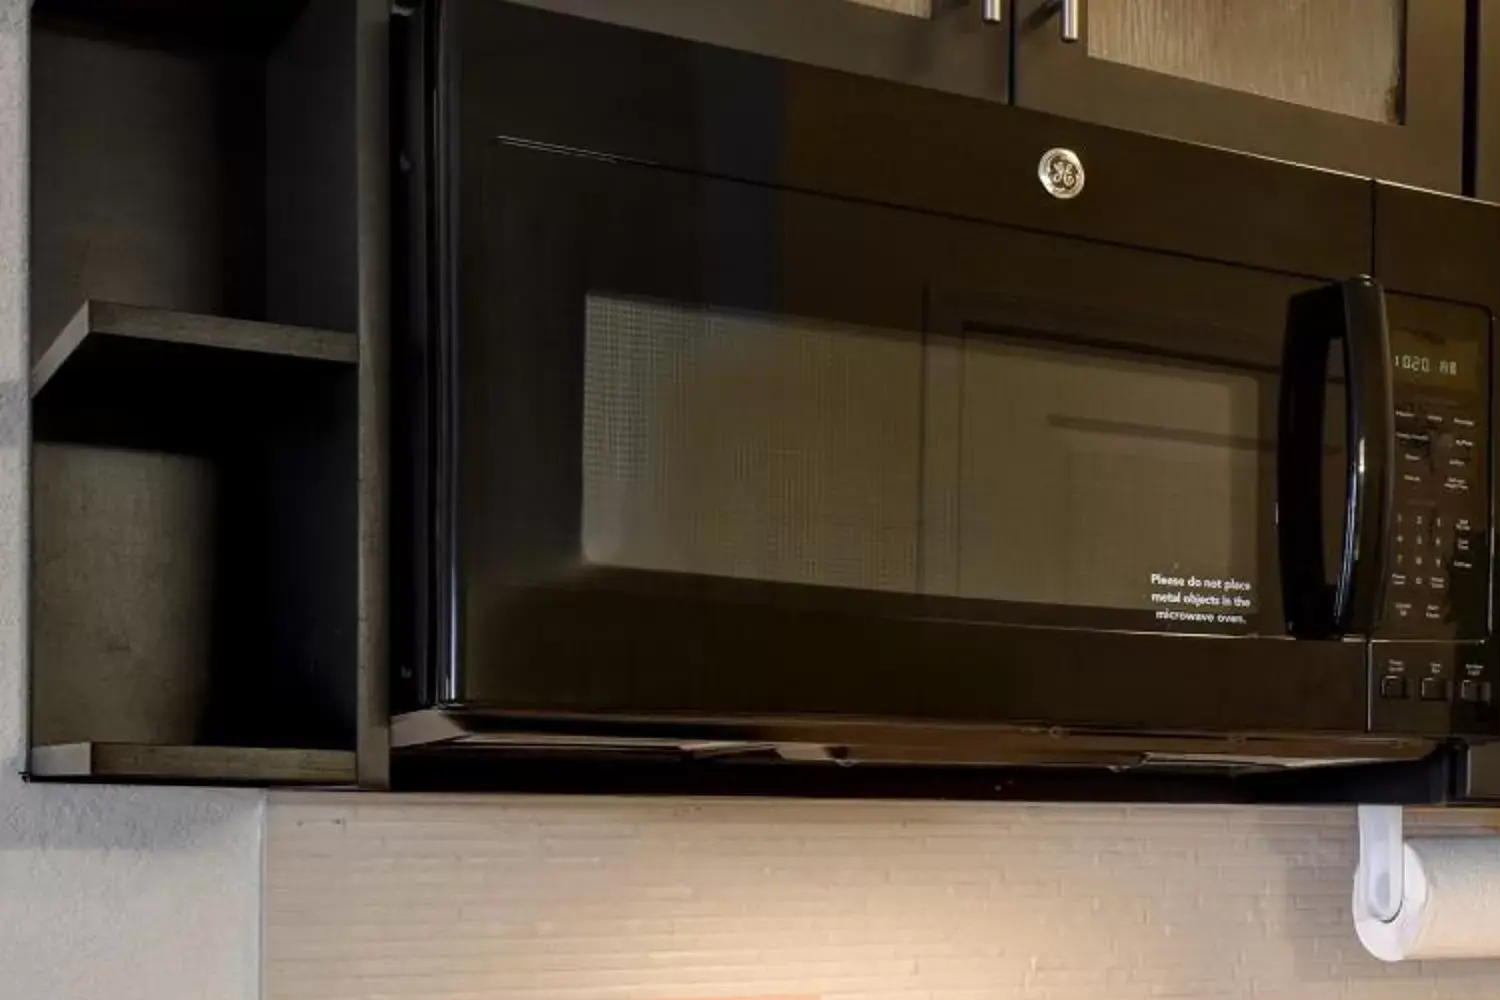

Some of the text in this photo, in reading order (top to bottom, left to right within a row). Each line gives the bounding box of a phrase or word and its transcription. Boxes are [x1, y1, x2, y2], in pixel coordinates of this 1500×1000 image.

[1151, 573, 1251, 592] Please do not place
[1151, 591, 1251, 608] metal objects in the
[1155, 608, 1247, 624] microwave oven.
